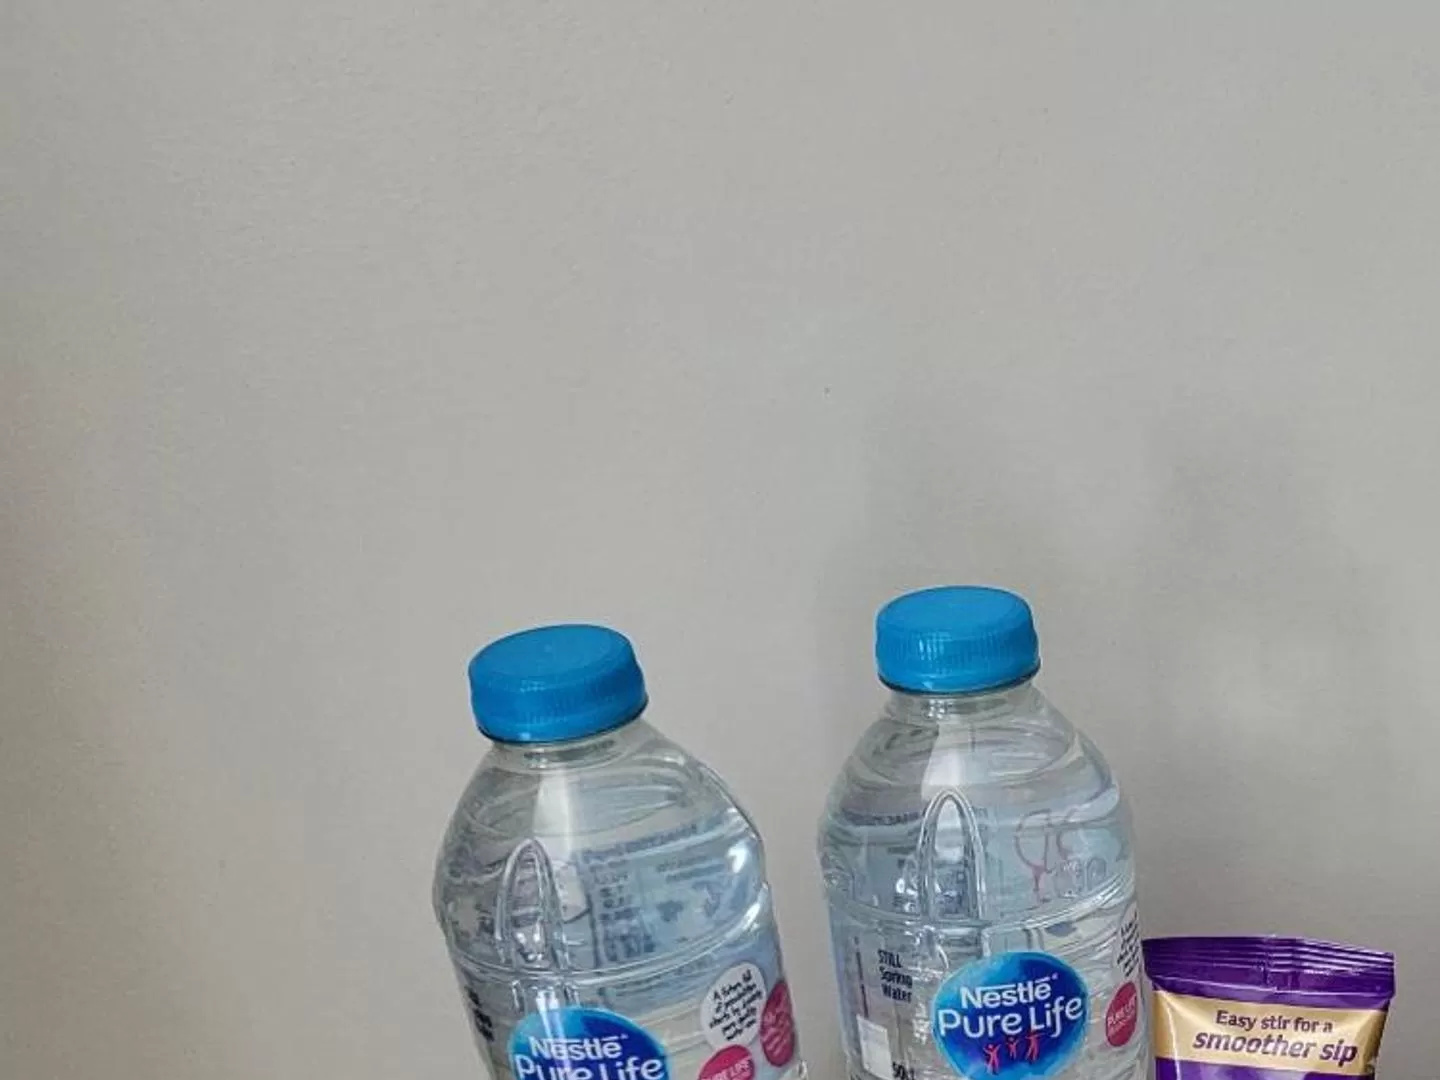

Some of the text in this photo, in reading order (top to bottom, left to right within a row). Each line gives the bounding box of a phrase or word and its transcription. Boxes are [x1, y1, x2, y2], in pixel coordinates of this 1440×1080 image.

[878, 949, 902, 968] STILL
[881, 984, 913, 1003] Water
[937, 996, 1084, 1038] Pure Life
[1216, 1010, 1334, 1032] Easy stir for a
[1193, 1031, 1359, 1067] smoother sip
